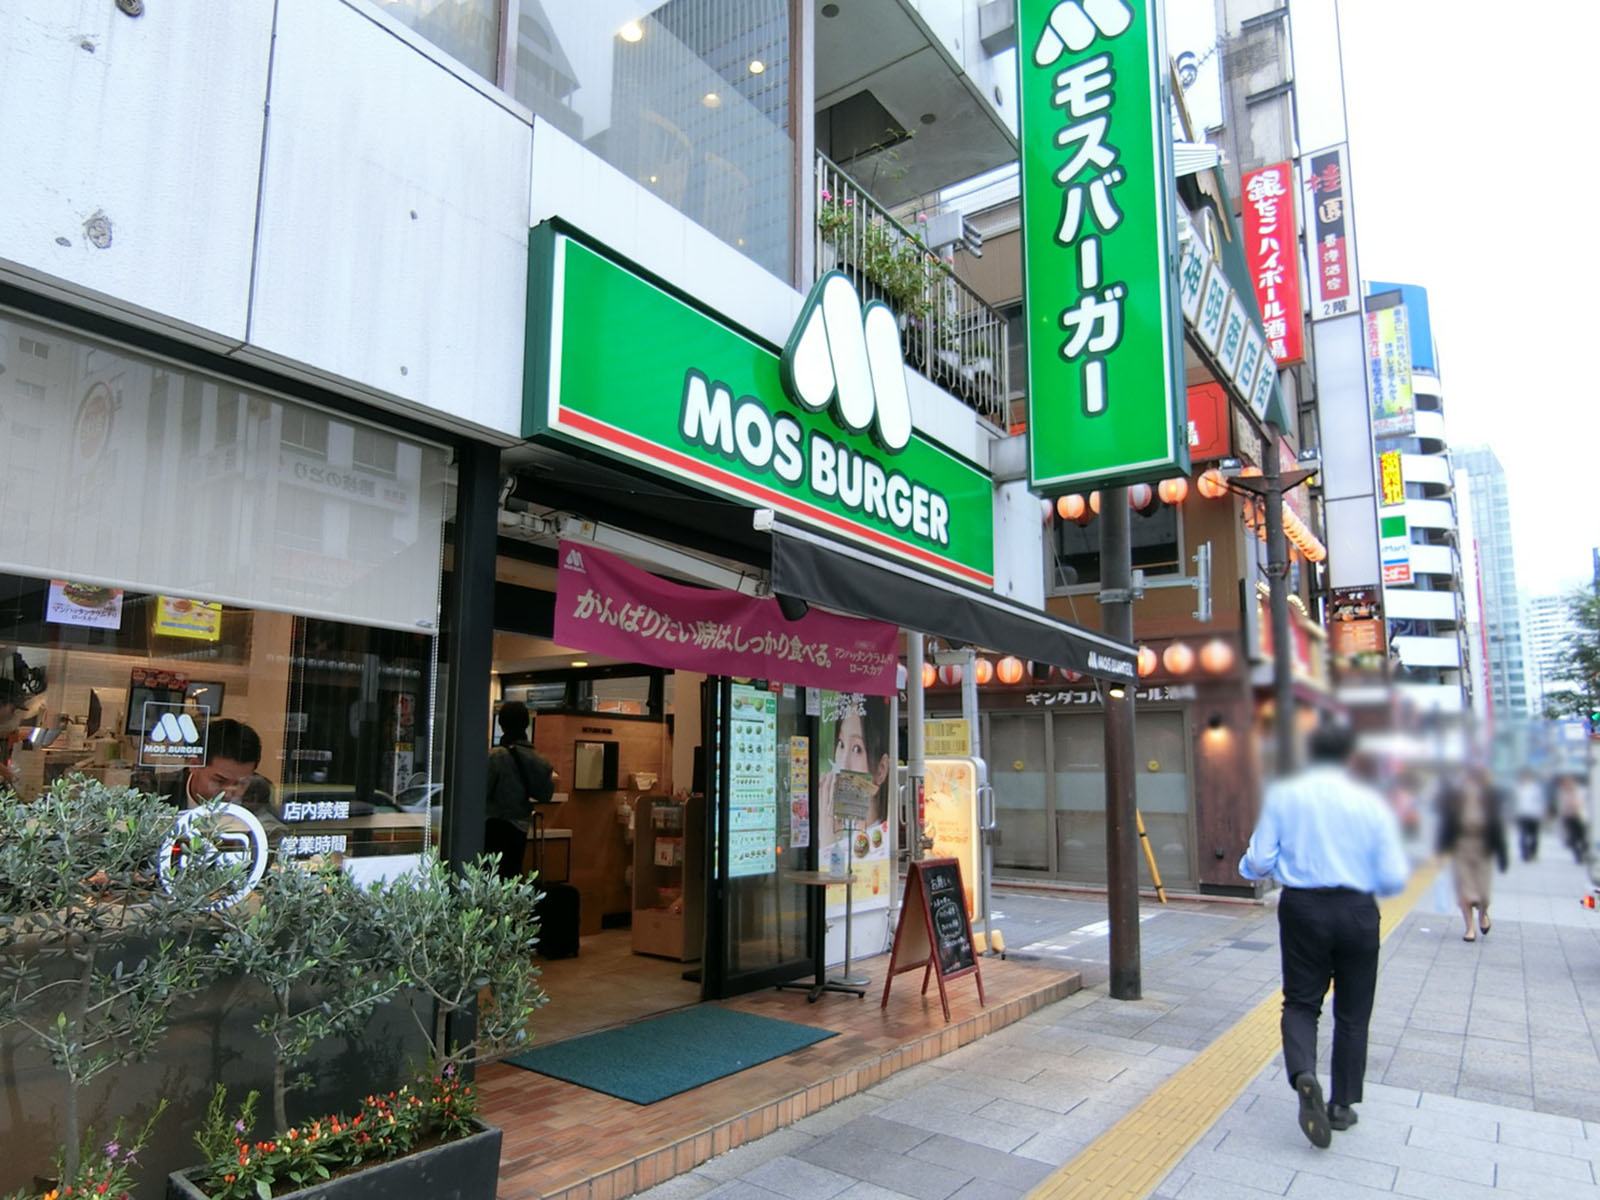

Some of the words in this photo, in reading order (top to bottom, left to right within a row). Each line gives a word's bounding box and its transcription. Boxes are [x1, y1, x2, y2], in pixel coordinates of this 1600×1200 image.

[1056, 54, 1122, 413] モスバーガー
[1323, 299, 1348, 315] 2階
[681, 373, 803, 483] MOS
[810, 435, 950, 546] BURGER
[572, 588, 832, 669] がんばりたい時は、しっかり食べる。
[144, 744, 167, 753] MOS
[168, 745, 204, 754] BURGER
[283, 801, 350, 821] 店内禁煙
[280, 834, 347, 856] 営業時間
